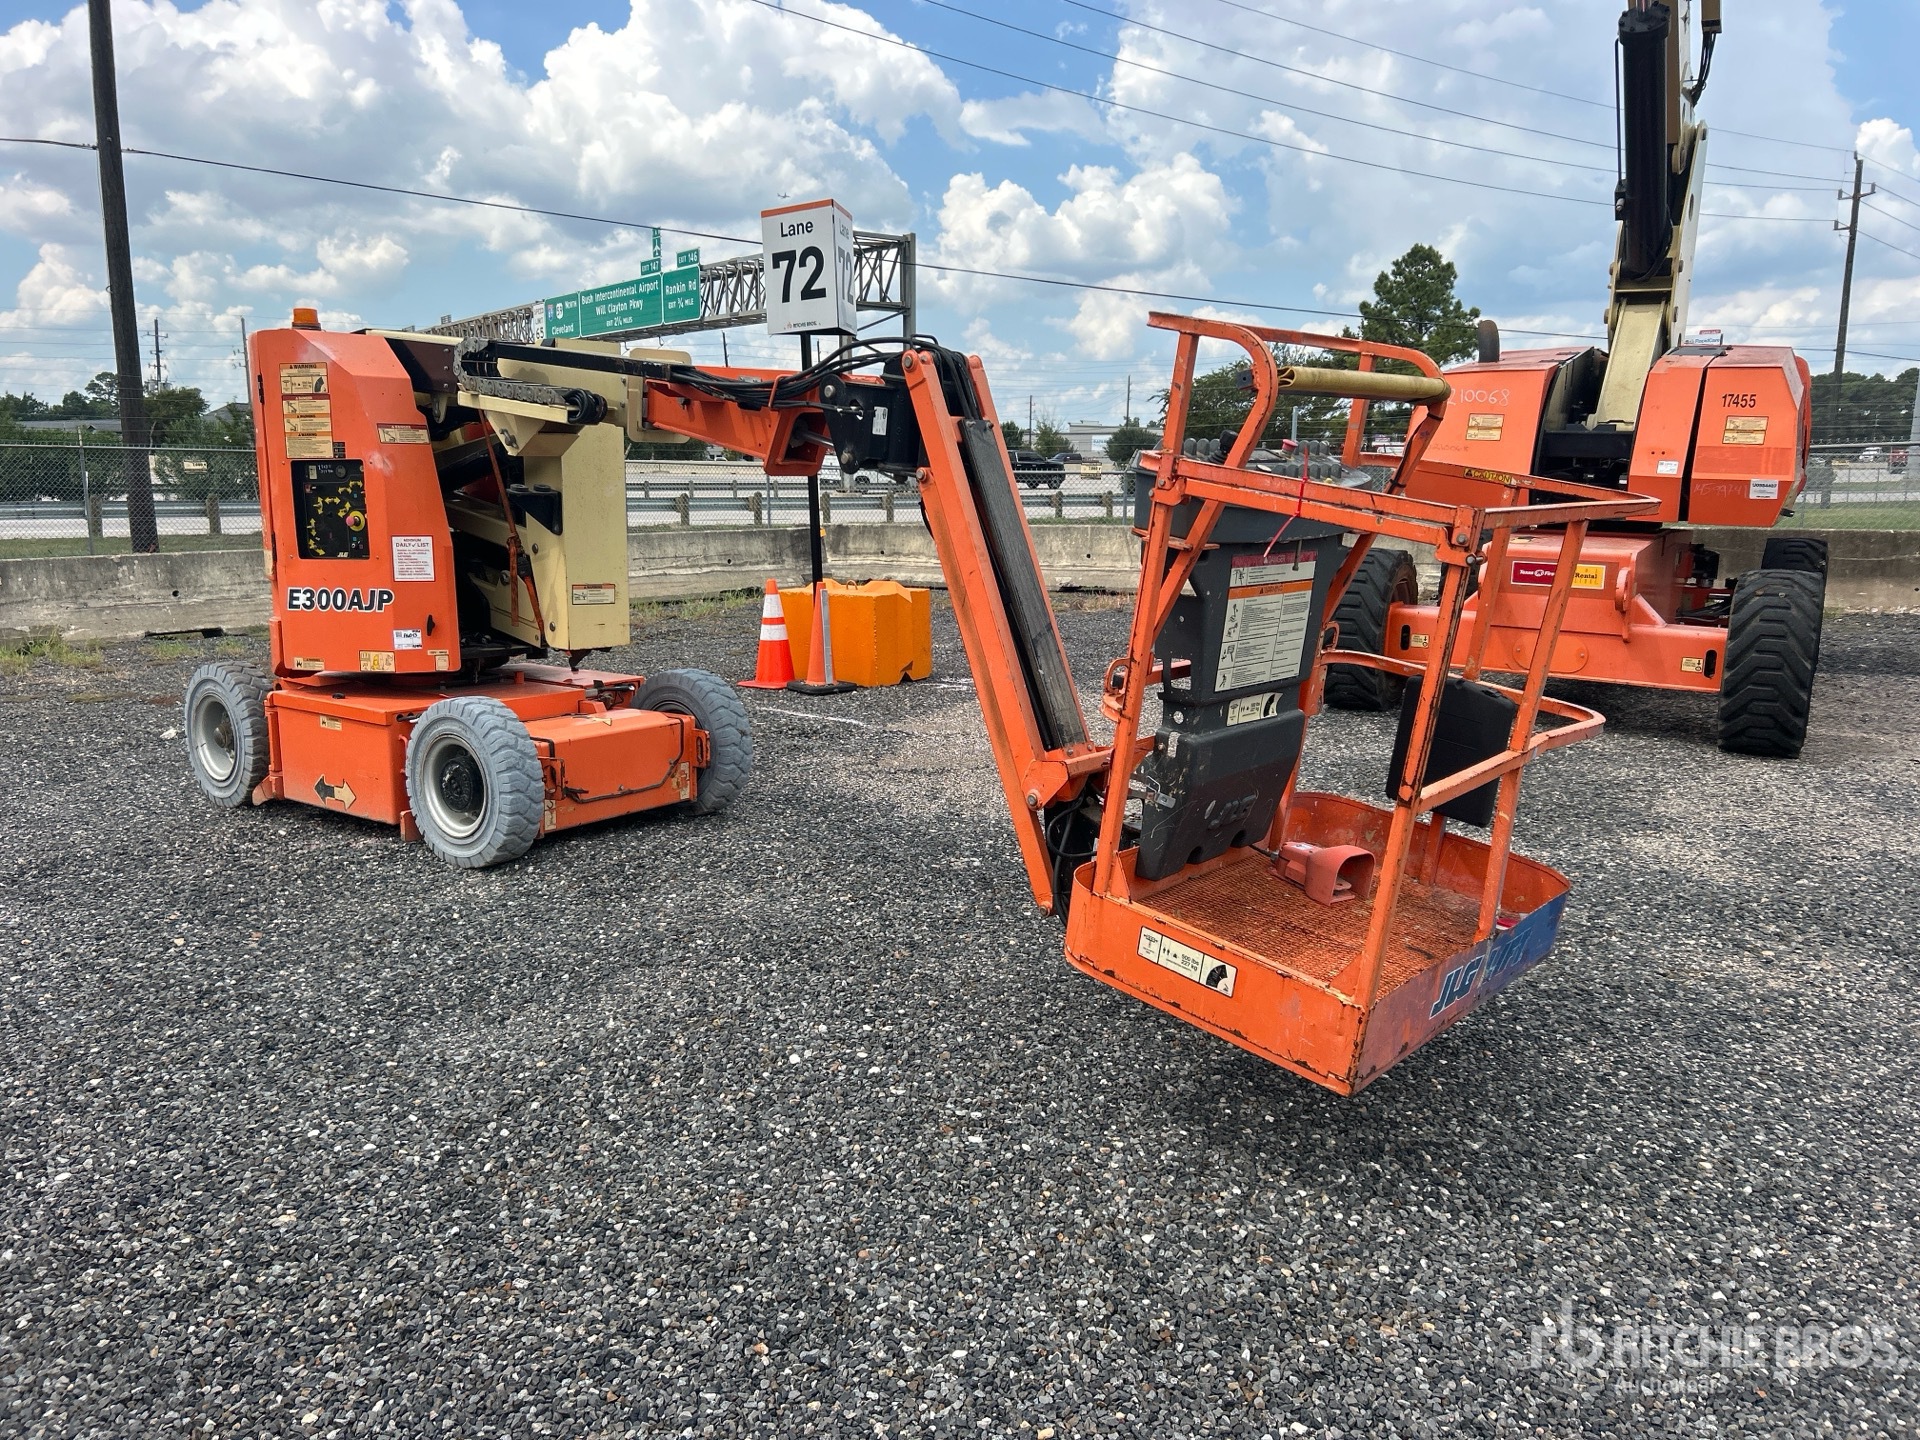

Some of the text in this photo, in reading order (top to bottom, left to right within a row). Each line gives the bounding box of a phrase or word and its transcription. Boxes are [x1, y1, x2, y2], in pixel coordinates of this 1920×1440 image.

[780, 221, 814, 238] Lane
[687, 251, 698, 263] 146
[650, 260, 659, 272] 147
[772, 246, 827, 304] 72
[837, 245, 855, 306] 72
[581, 281, 659, 305] Bush Intercontinental Airport
[665, 279, 697, 296] Rankin Rd
[595, 299, 644, 316] Will Clayton Pkwy
[668, 301, 677, 309] EXIT
[684, 298, 694, 306] MILE
[535, 326, 545, 340] 65
[551, 322, 574, 335] Cleveland
[1721, 393, 1757, 409] 17455
[1473, 469, 1511, 485] CAUTION
[1574, 572, 1598, 580] Rental
[288, 587, 394, 612] E300AJP
[1428, 954, 1486, 1020] JLG
